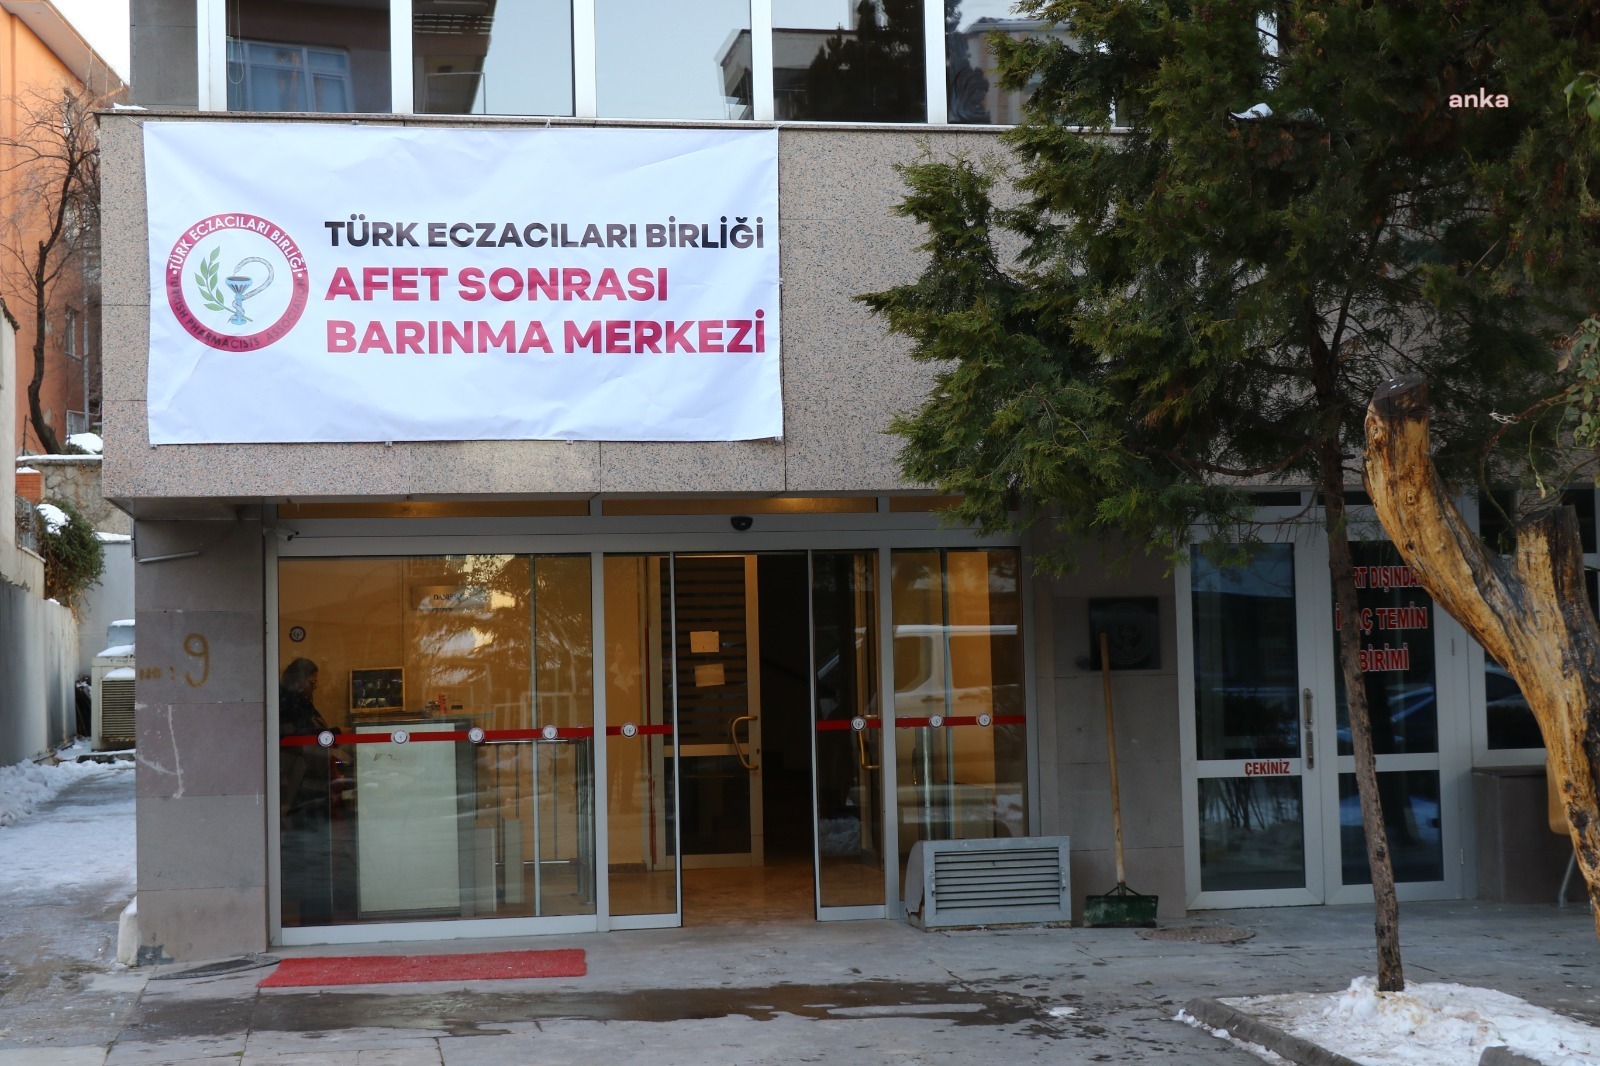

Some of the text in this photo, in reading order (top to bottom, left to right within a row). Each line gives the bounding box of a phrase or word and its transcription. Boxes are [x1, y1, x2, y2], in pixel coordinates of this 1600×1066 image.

[169, 216, 308, 273] TÜRK ECZACILARI BİRLİĞİ
[324, 213, 764, 249] TÜRK ECZACILARI BİRLİĞİ
[324, 266, 668, 302] AFET SONRASI
[170, 275, 306, 349] TURKISH PHARMACISTS ASSOCIATION
[326, 308, 766, 355] BARINMA MERKEZİ
[1369, 565, 1424, 593] DIŞINDA
[1375, 601, 1428, 630] TEMİN
[183, 632, 210, 688] 9
[1360, 642, 1410, 672] BİRİMİ
[1244, 758, 1290, 778] ÇEKİNİZ
